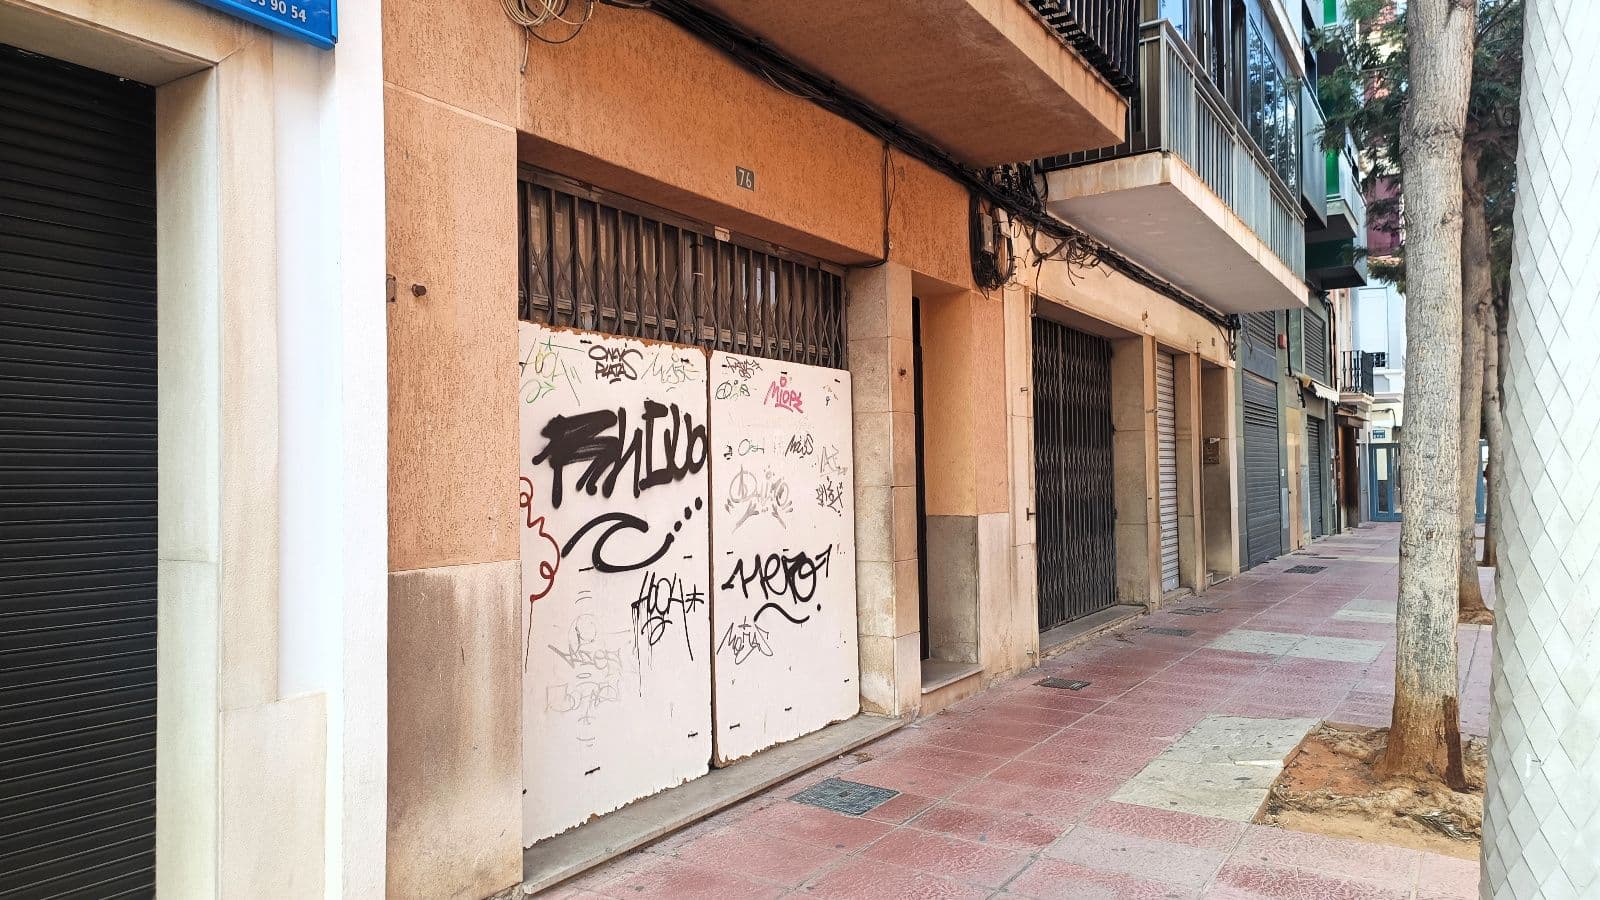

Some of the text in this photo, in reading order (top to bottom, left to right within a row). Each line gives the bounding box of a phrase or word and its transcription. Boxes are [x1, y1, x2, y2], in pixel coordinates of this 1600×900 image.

[271, 0, 307, 22] 90 54
[739, 169, 752, 188] 76
